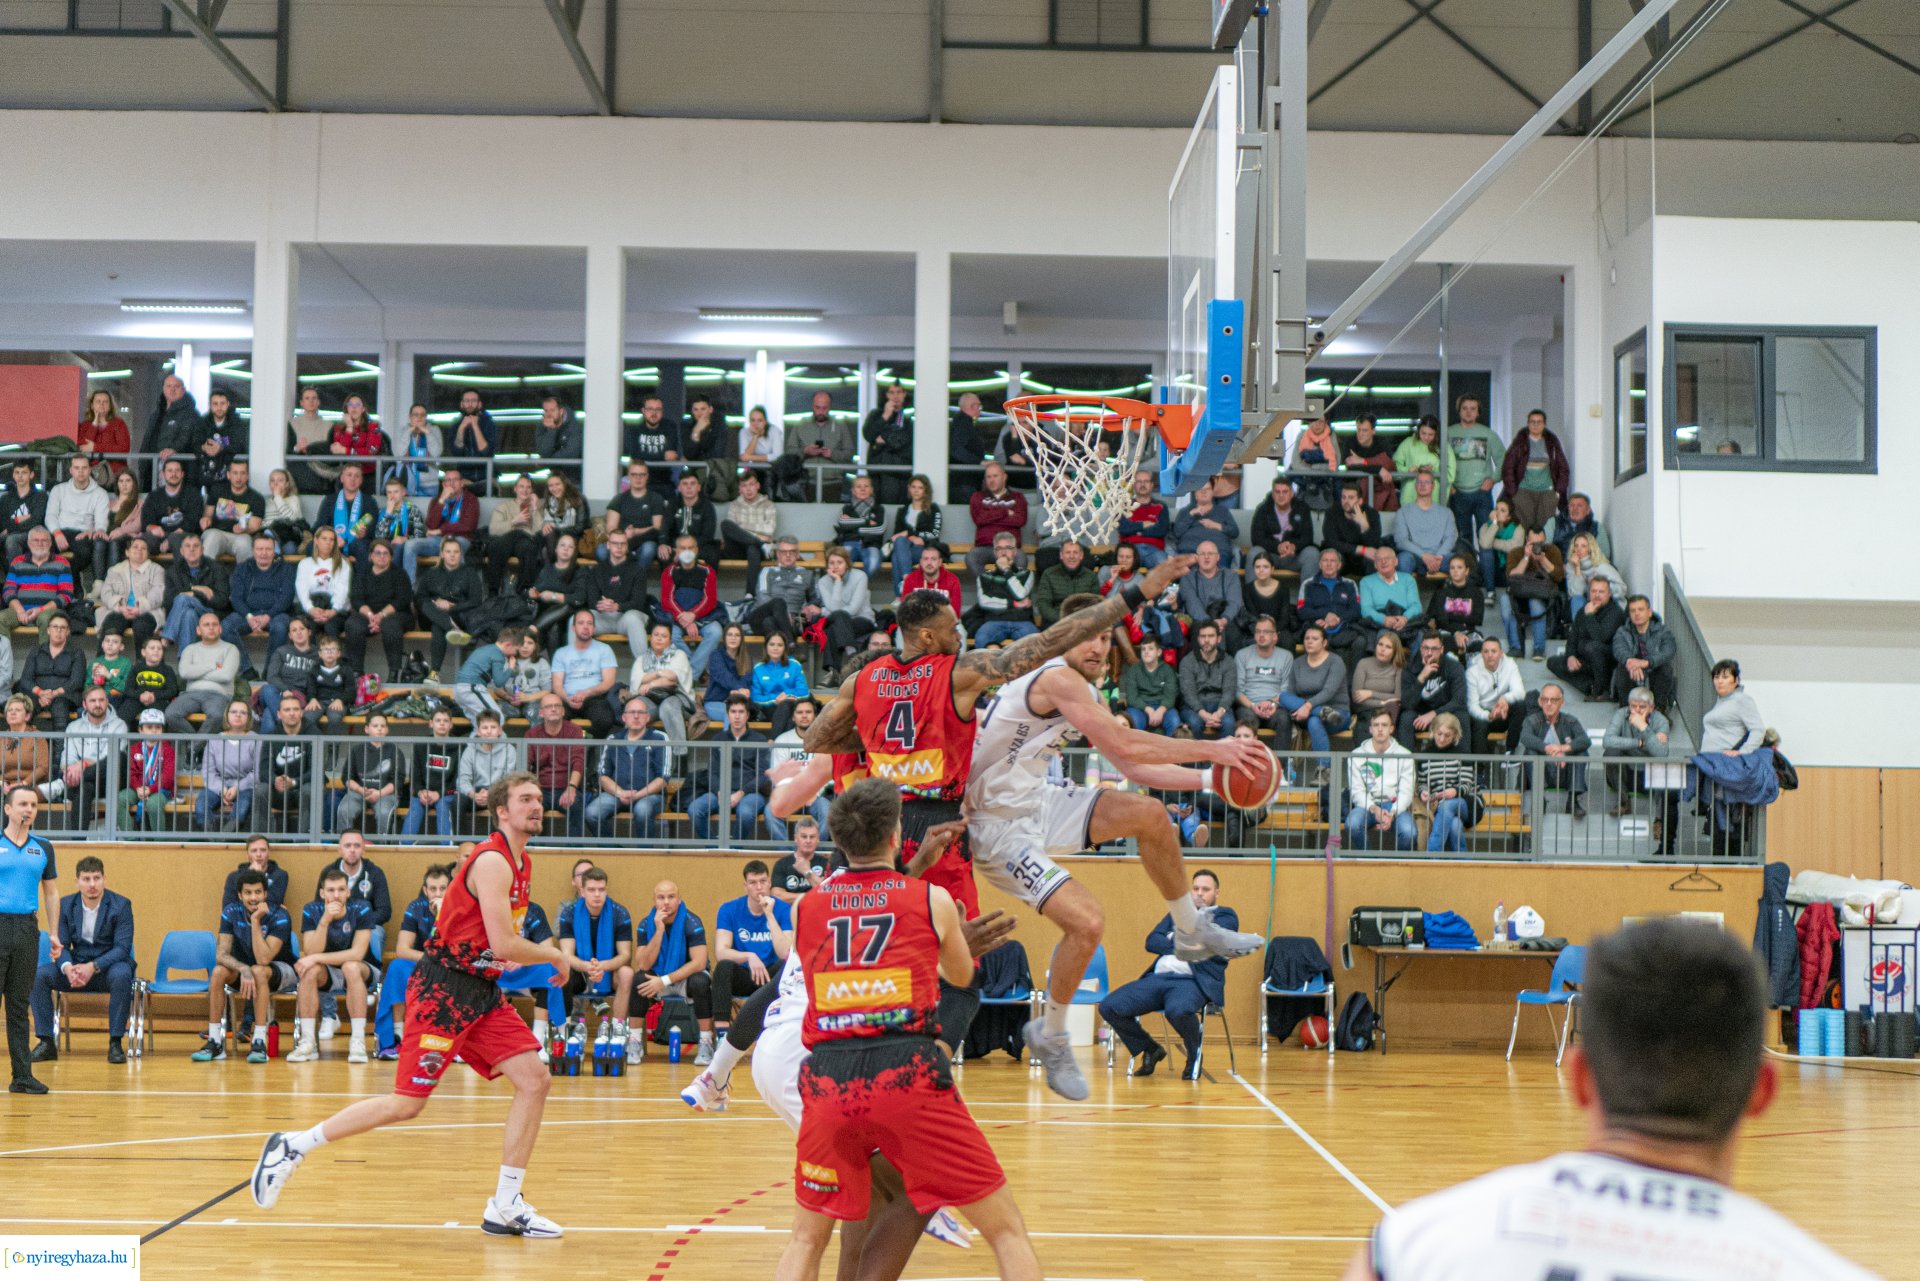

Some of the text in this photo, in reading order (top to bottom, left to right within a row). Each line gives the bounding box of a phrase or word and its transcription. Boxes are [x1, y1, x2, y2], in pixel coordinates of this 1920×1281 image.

[885, 700, 916, 750] 4
[878, 759, 935, 778] MVM
[1012, 855, 1045, 890] 35
[831, 893, 888, 910] LIONS
[827, 912, 895, 966] 17
[826, 978, 898, 1000] MVM
